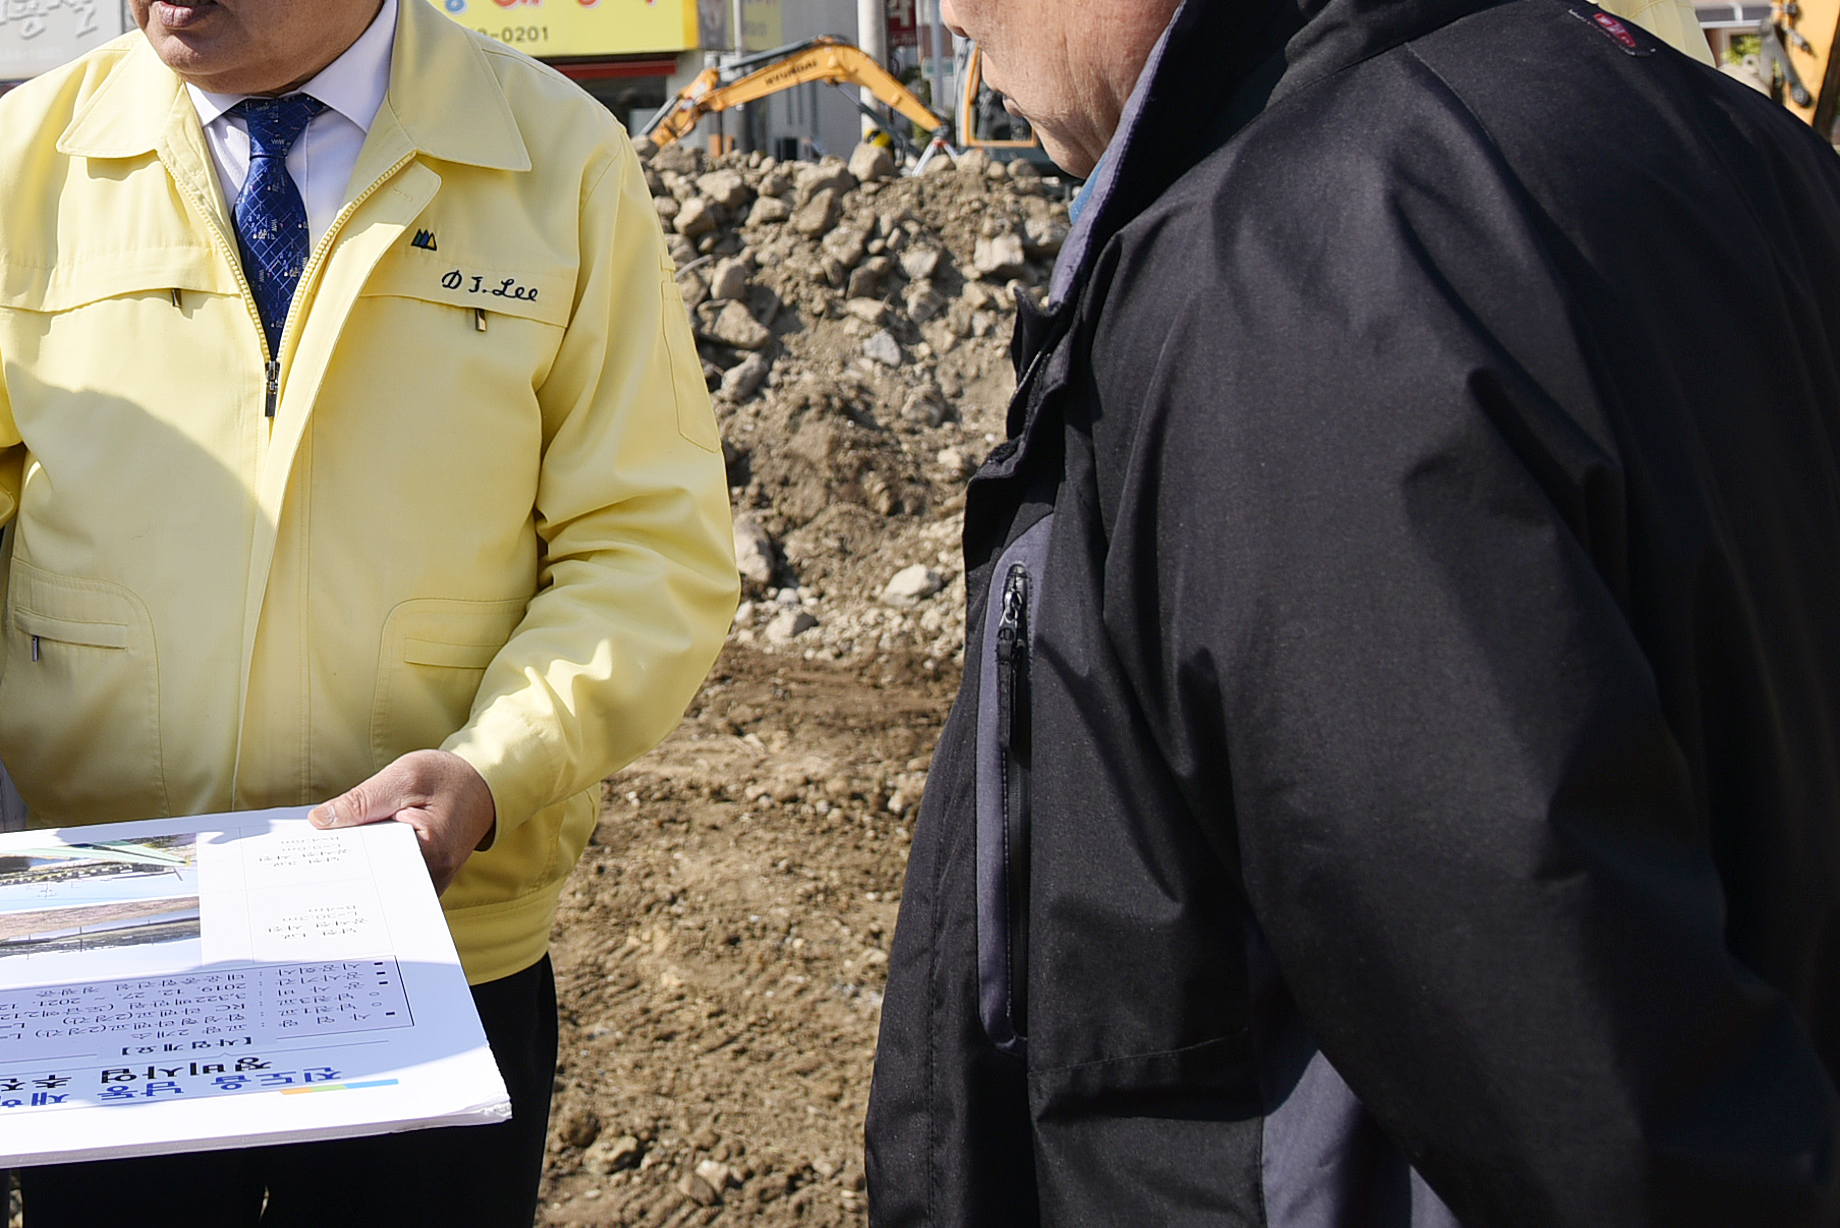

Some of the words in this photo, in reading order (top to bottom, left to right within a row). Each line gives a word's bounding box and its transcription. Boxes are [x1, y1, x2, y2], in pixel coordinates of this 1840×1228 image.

[100, 1054, 272, 1084] 정비사업
[209, 1065, 343, 1092] 진도읍
[95, 1079, 182, 1102] 남동
